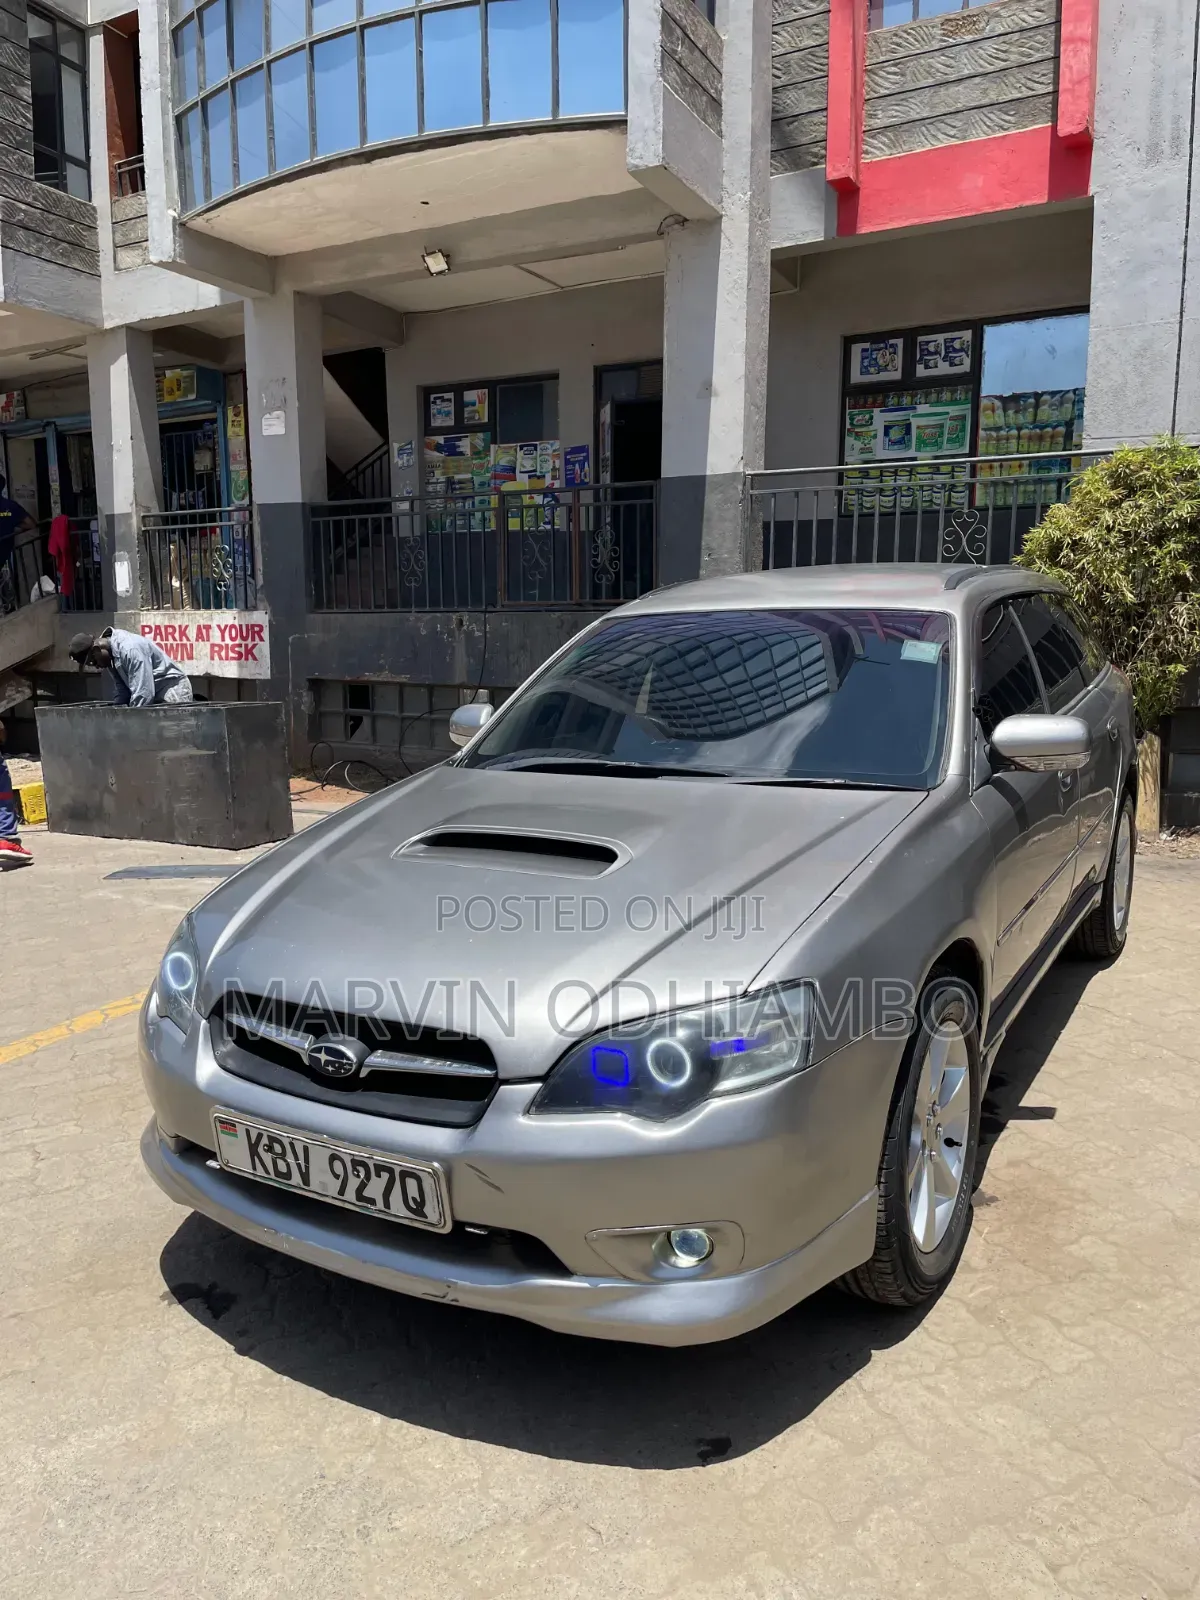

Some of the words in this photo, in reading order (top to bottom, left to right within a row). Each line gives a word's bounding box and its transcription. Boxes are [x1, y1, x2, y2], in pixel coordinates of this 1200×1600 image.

[140, 624, 191, 642] PARK
[195, 624, 212, 642] AT
[216, 623, 265, 642] YOUR
[209, 642, 259, 661] RISK
[245, 1128, 310, 1187] KBV
[328, 1152, 428, 1219] 927Q
